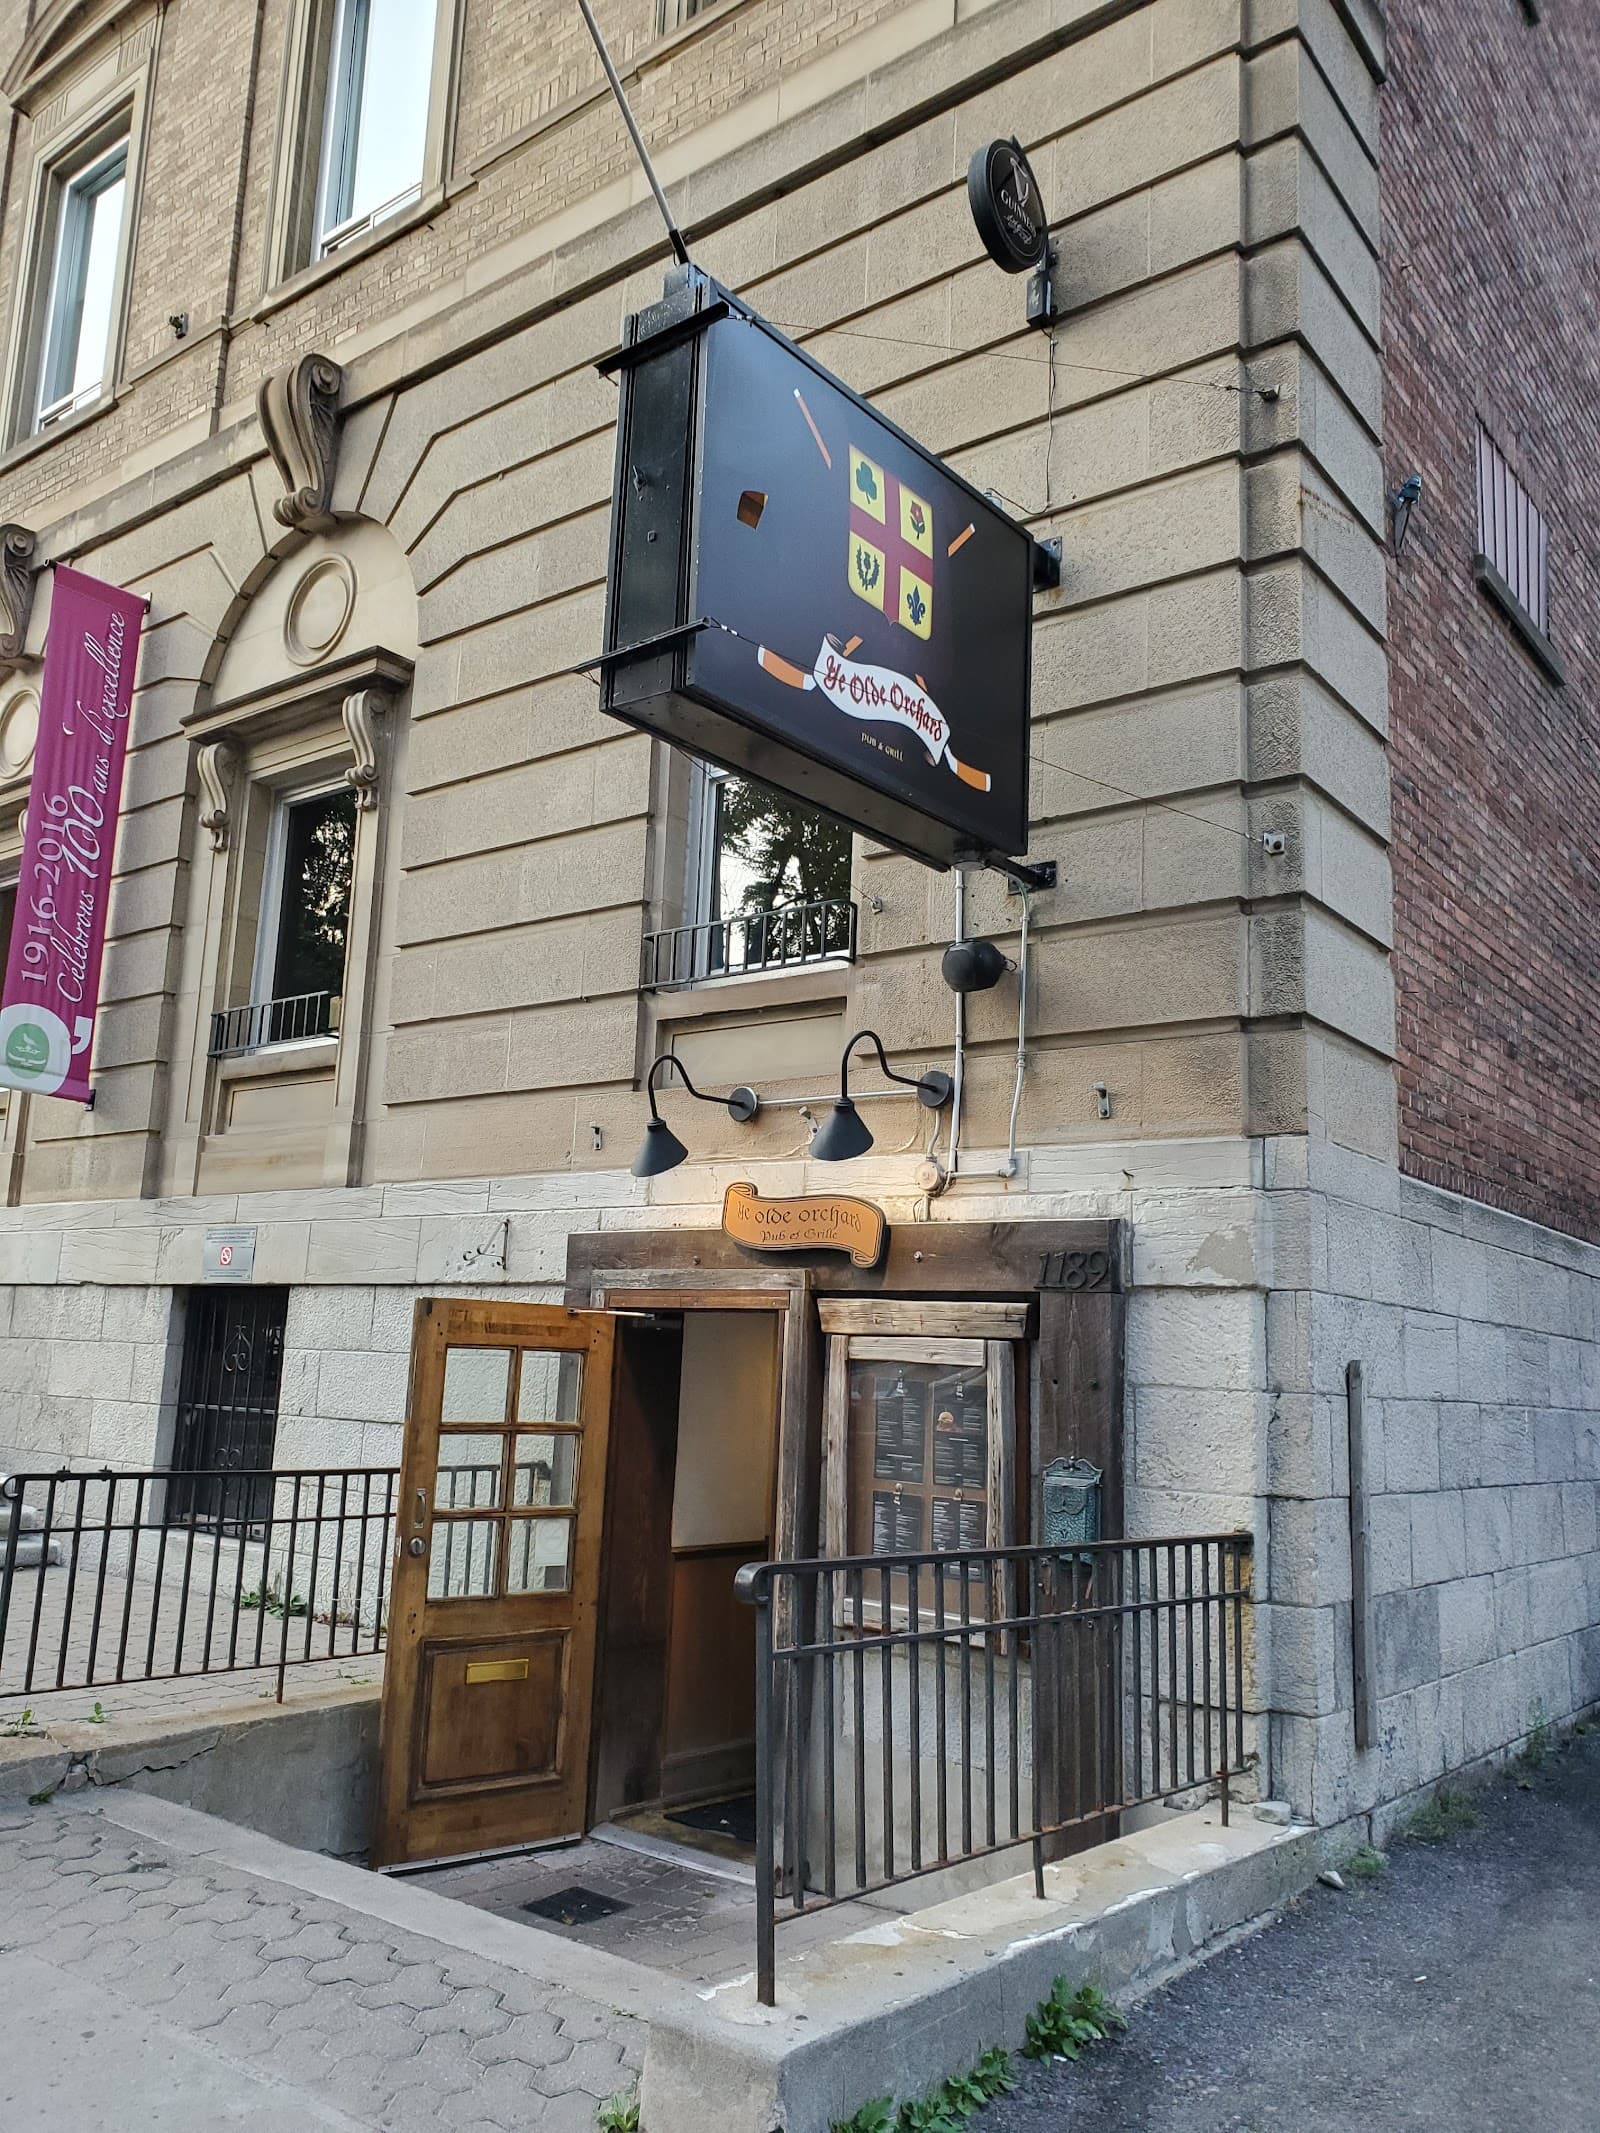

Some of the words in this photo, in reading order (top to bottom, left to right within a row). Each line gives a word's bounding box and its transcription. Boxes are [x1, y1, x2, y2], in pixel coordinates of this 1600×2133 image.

[77, 611, 128, 746] d'excellence
[824, 655, 846, 693] Ye
[850, 673, 886, 706] Olde
[890, 682, 943, 742] Orchard
[92, 754, 110, 794] ans
[61, 785, 104, 879] 100
[21, 792, 69, 986] 1916-2016
[50, 890, 95, 1002] Célébrons
[1033, 1250, 1111, 1290] 1189
